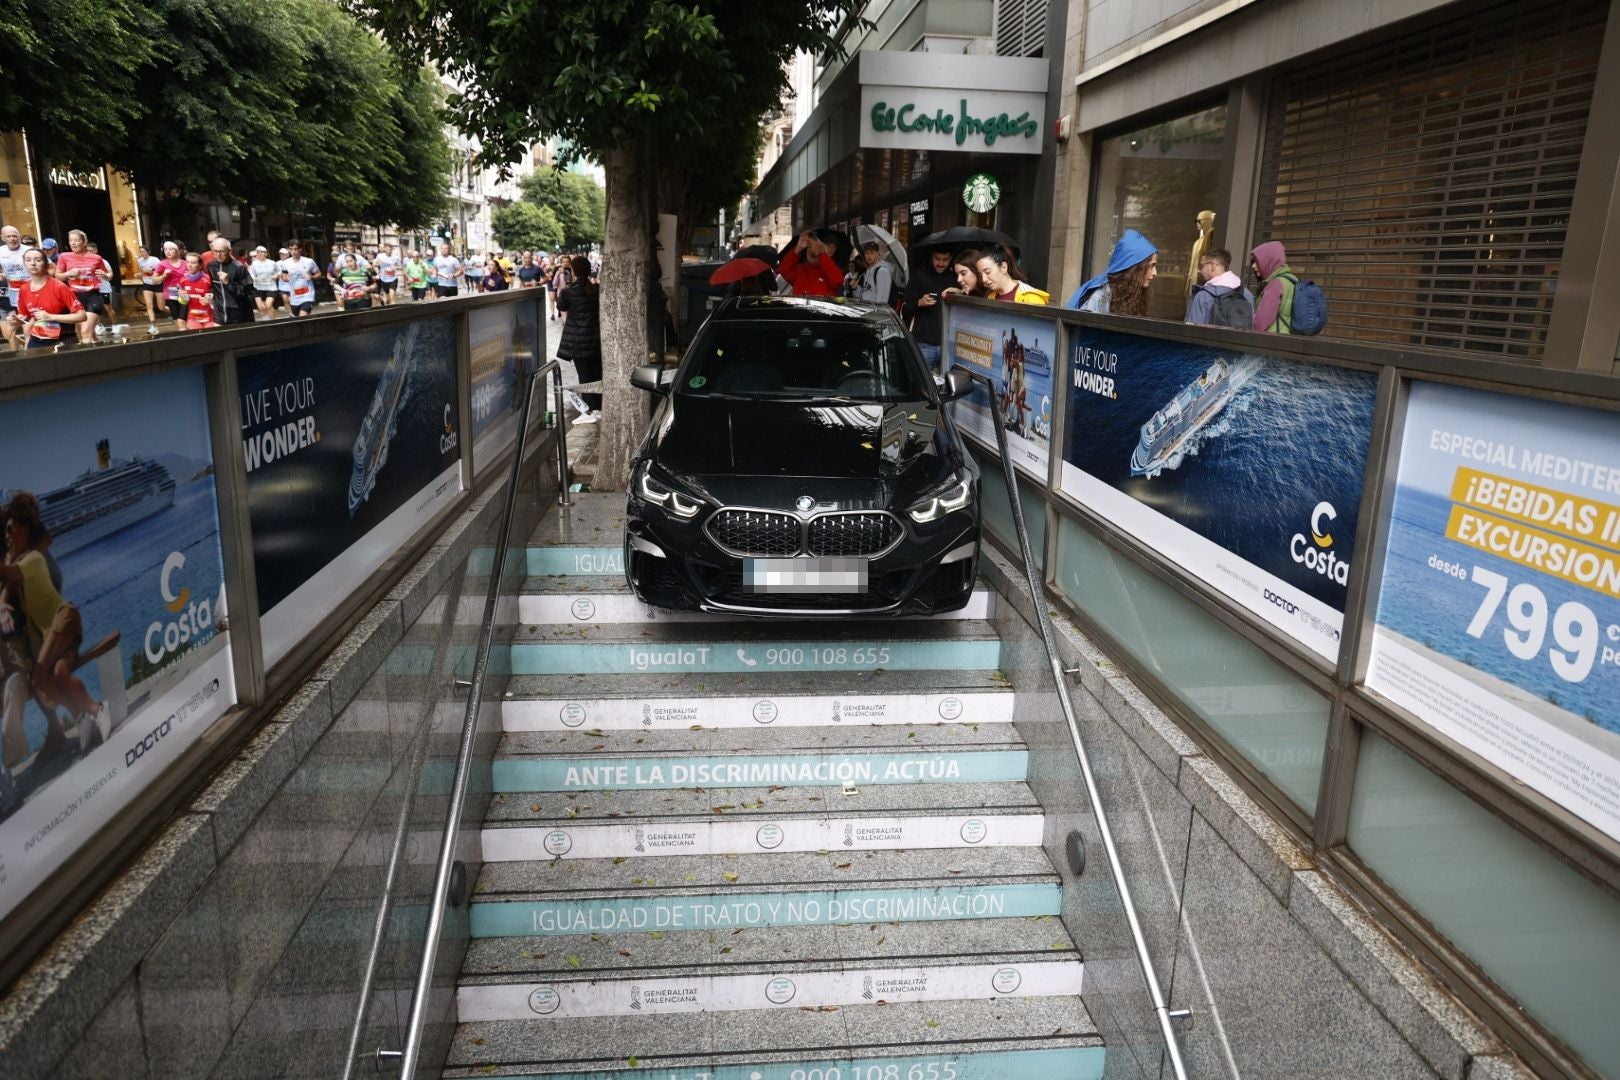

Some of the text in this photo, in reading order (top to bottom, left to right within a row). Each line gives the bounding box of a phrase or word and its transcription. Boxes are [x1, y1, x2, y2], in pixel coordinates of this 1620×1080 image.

[871, 99, 1038, 146] El Corte Inglés
[1074, 345, 1118, 374] LIVE YOUR
[1073, 368, 1118, 400] WONDER.
[240, 377, 315, 430] LIVE YOUR
[243, 415, 320, 473] WONDER.
[1430, 430, 1620, 495] ESPECIAL MEDITER
[1465, 477, 1597, 535] ¡BEBIDAS
[1290, 532, 1350, 587] Costa
[1457, 514, 1620, 593] EXCURSION
[144, 597, 211, 665] Costa
[1428, 554, 1467, 580] desde
[1466, 565, 1599, 683] 799
[630, 647, 890, 670] IgualaT 900 108 655
[843, 710, 885, 718] VALENCIANA
[564, 756, 960, 787] ANTE LA DISCRIMINACIÓN, ACTÚA
[647, 833, 696, 841] GENERALITAT
[532, 889, 1005, 931] IGUALDAD DE TRATO Y NO DISCRIMINACIÓN
[643, 988, 698, 997] GENERALITAT
[875, 978, 928, 986] GENERALITAT
[876, 985, 927, 993] VALENCIANA
[644, 996, 697, 1004] VALENCIANA
[852, 1064, 900, 1080] 108
[908, 1061, 957, 1080] 655
